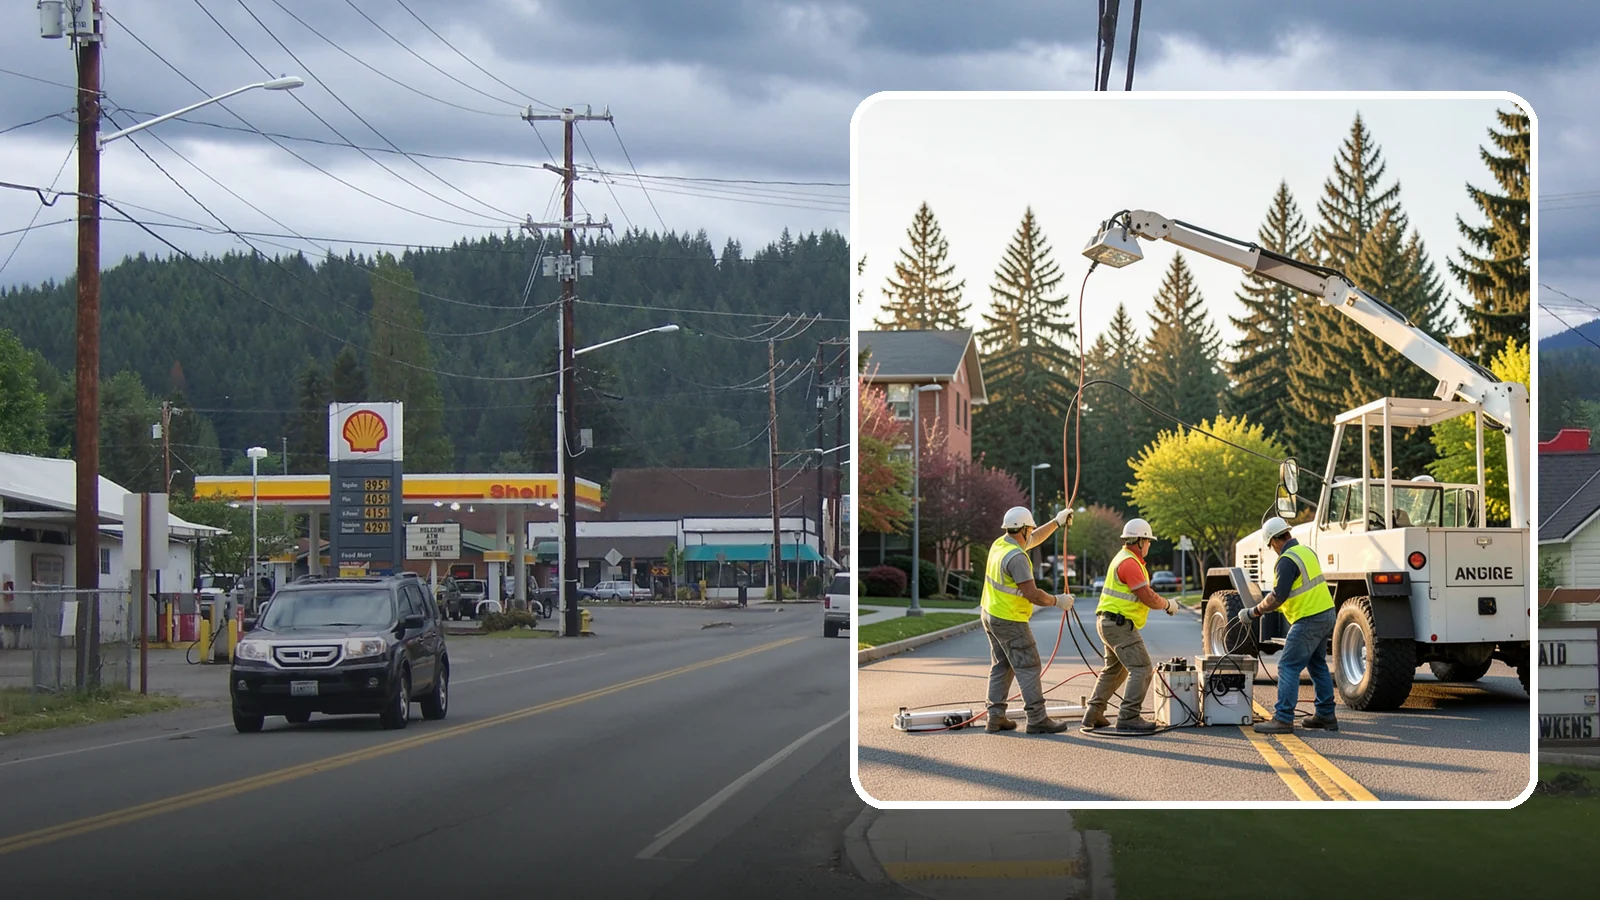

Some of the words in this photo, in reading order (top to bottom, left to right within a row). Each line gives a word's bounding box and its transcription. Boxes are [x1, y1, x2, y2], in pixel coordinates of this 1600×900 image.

[365, 479, 384, 490] 395
[489, 484, 547, 499] Shell
[365, 494, 384, 504] 405
[365, 508, 384, 518] 415
[365, 522, 384, 533] 429
[1538, 642, 1567, 666] AID
